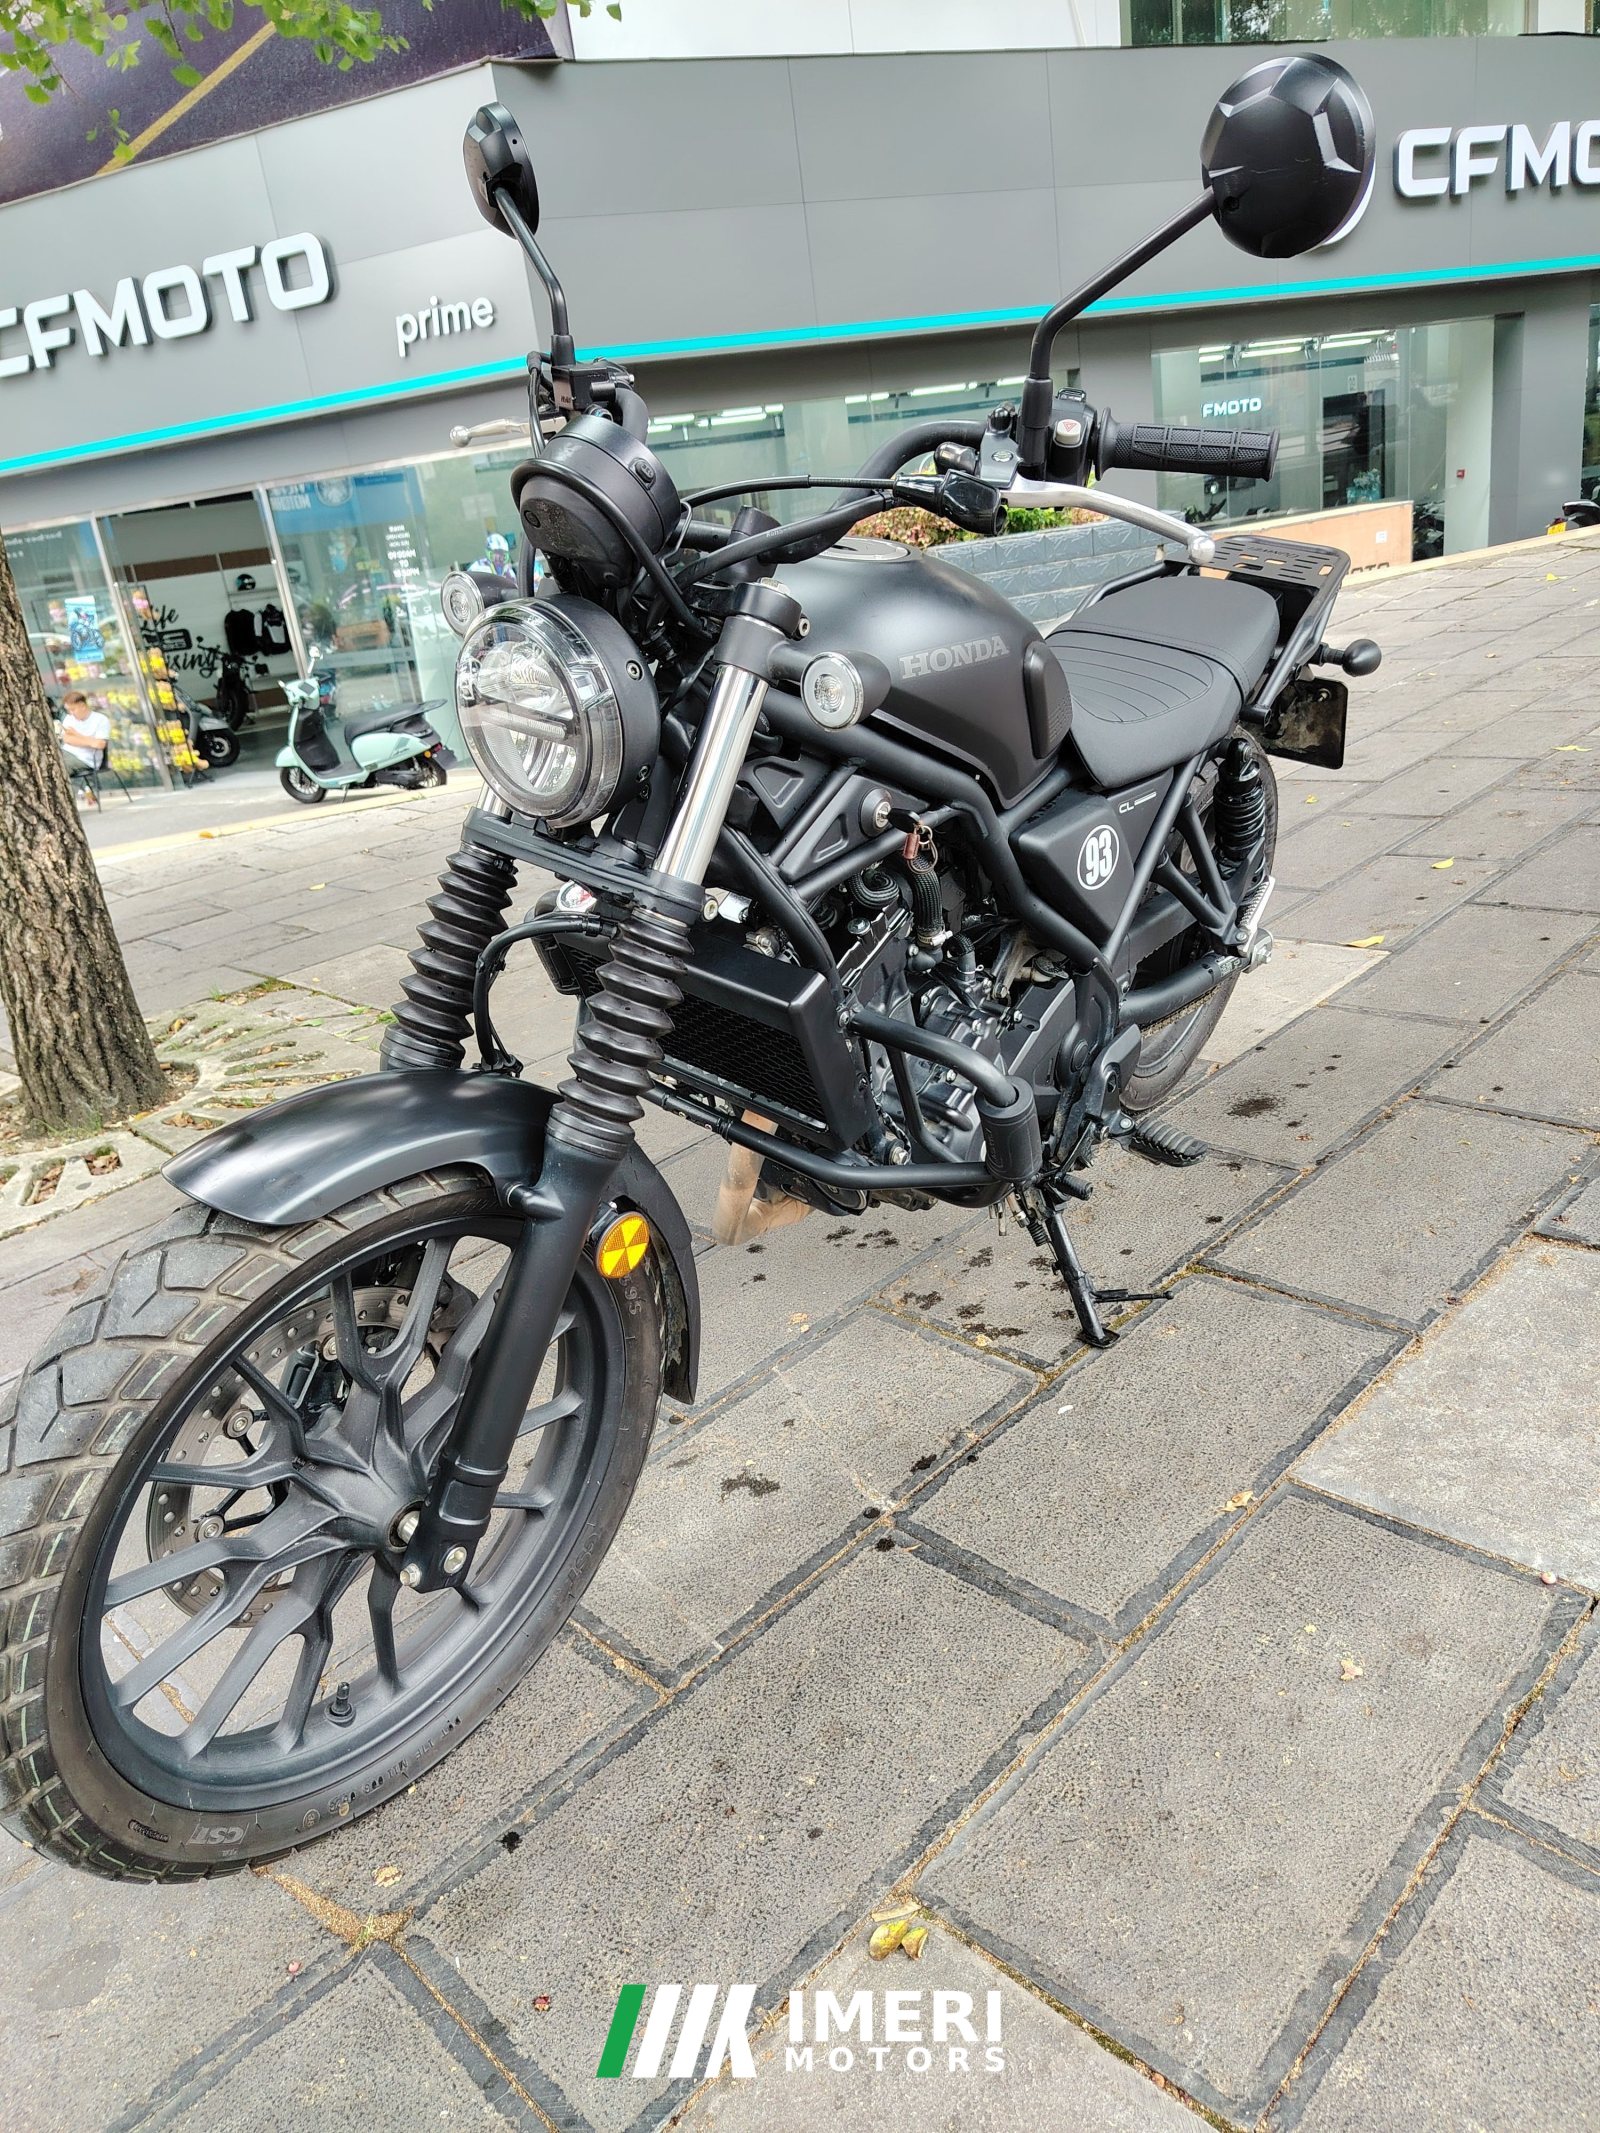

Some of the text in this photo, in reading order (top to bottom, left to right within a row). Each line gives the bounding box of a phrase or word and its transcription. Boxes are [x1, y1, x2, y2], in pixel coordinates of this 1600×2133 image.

[395, 295, 494, 358] prime
[1200, 397, 1262, 418] FMOTO
[899, 635, 1010, 679] HONDA
[1118, 802, 1135, 814] CL
[1085, 829, 1113, 885] 93
[190, 1825, 245, 1846] CST
